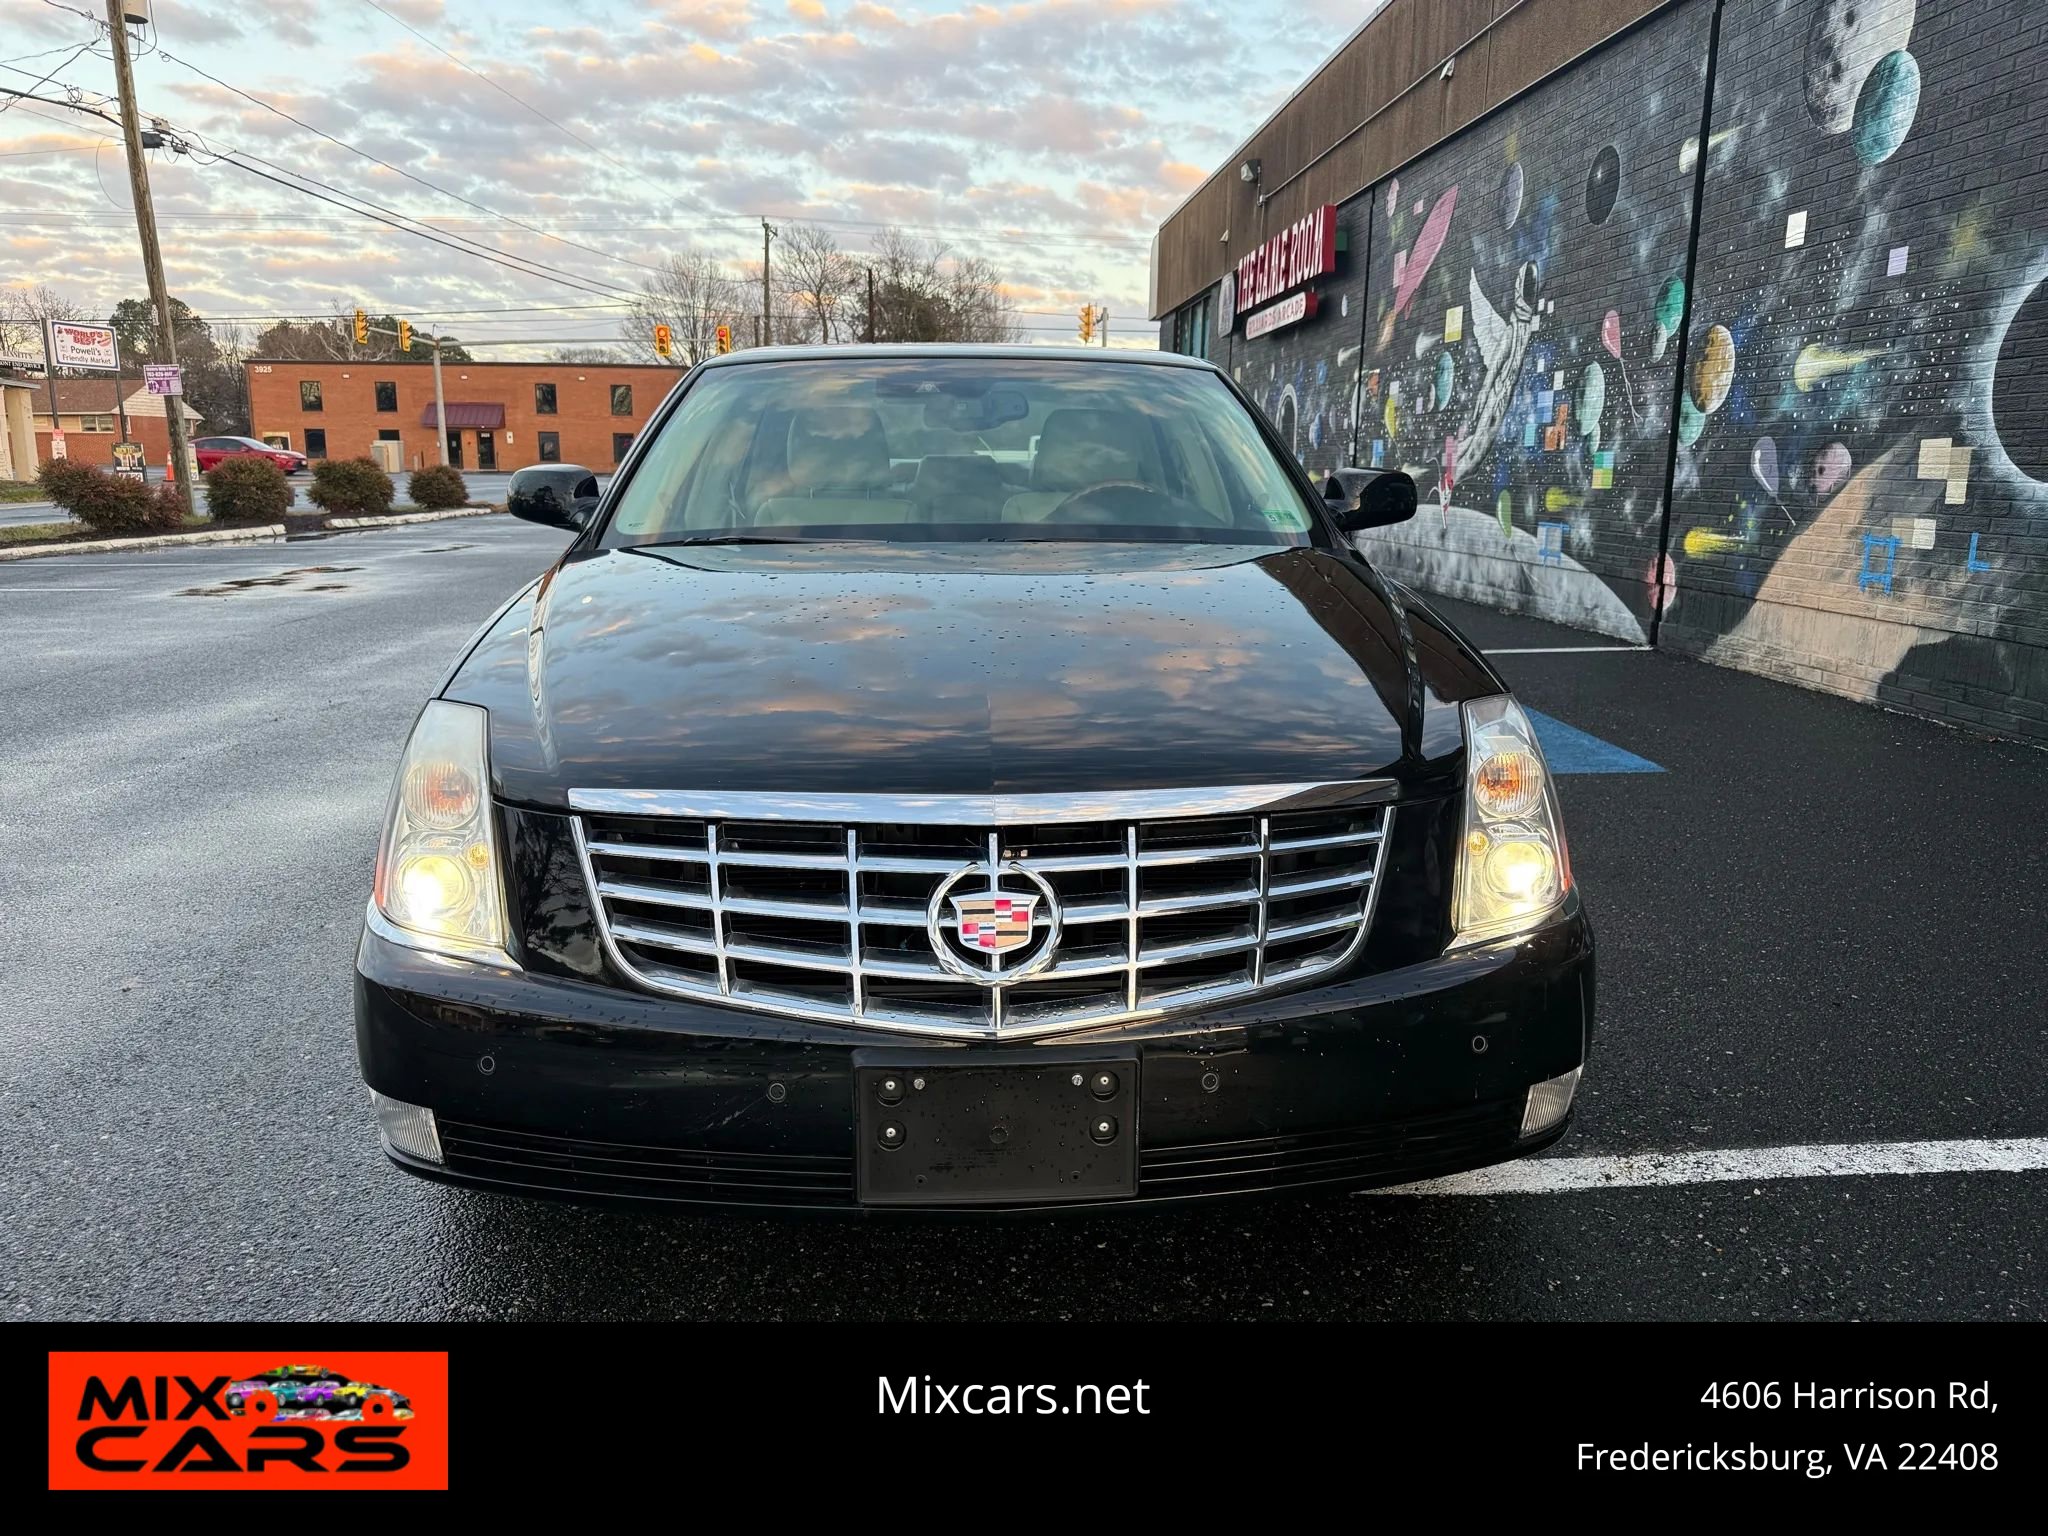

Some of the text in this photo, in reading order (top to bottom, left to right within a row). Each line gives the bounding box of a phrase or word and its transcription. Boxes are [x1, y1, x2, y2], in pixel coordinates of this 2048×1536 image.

[1237, 249, 1256, 314] THE
[1255, 228, 1288, 305] GAME
[1288, 204, 1325, 288] ROOM
[64, 328, 103, 338] WORLD'S
[72, 335, 97, 346] BEST
[70, 345, 101, 356] Powell's
[62, 354, 112, 365] Friendly Market
[254, 365, 272, 373] 3925
